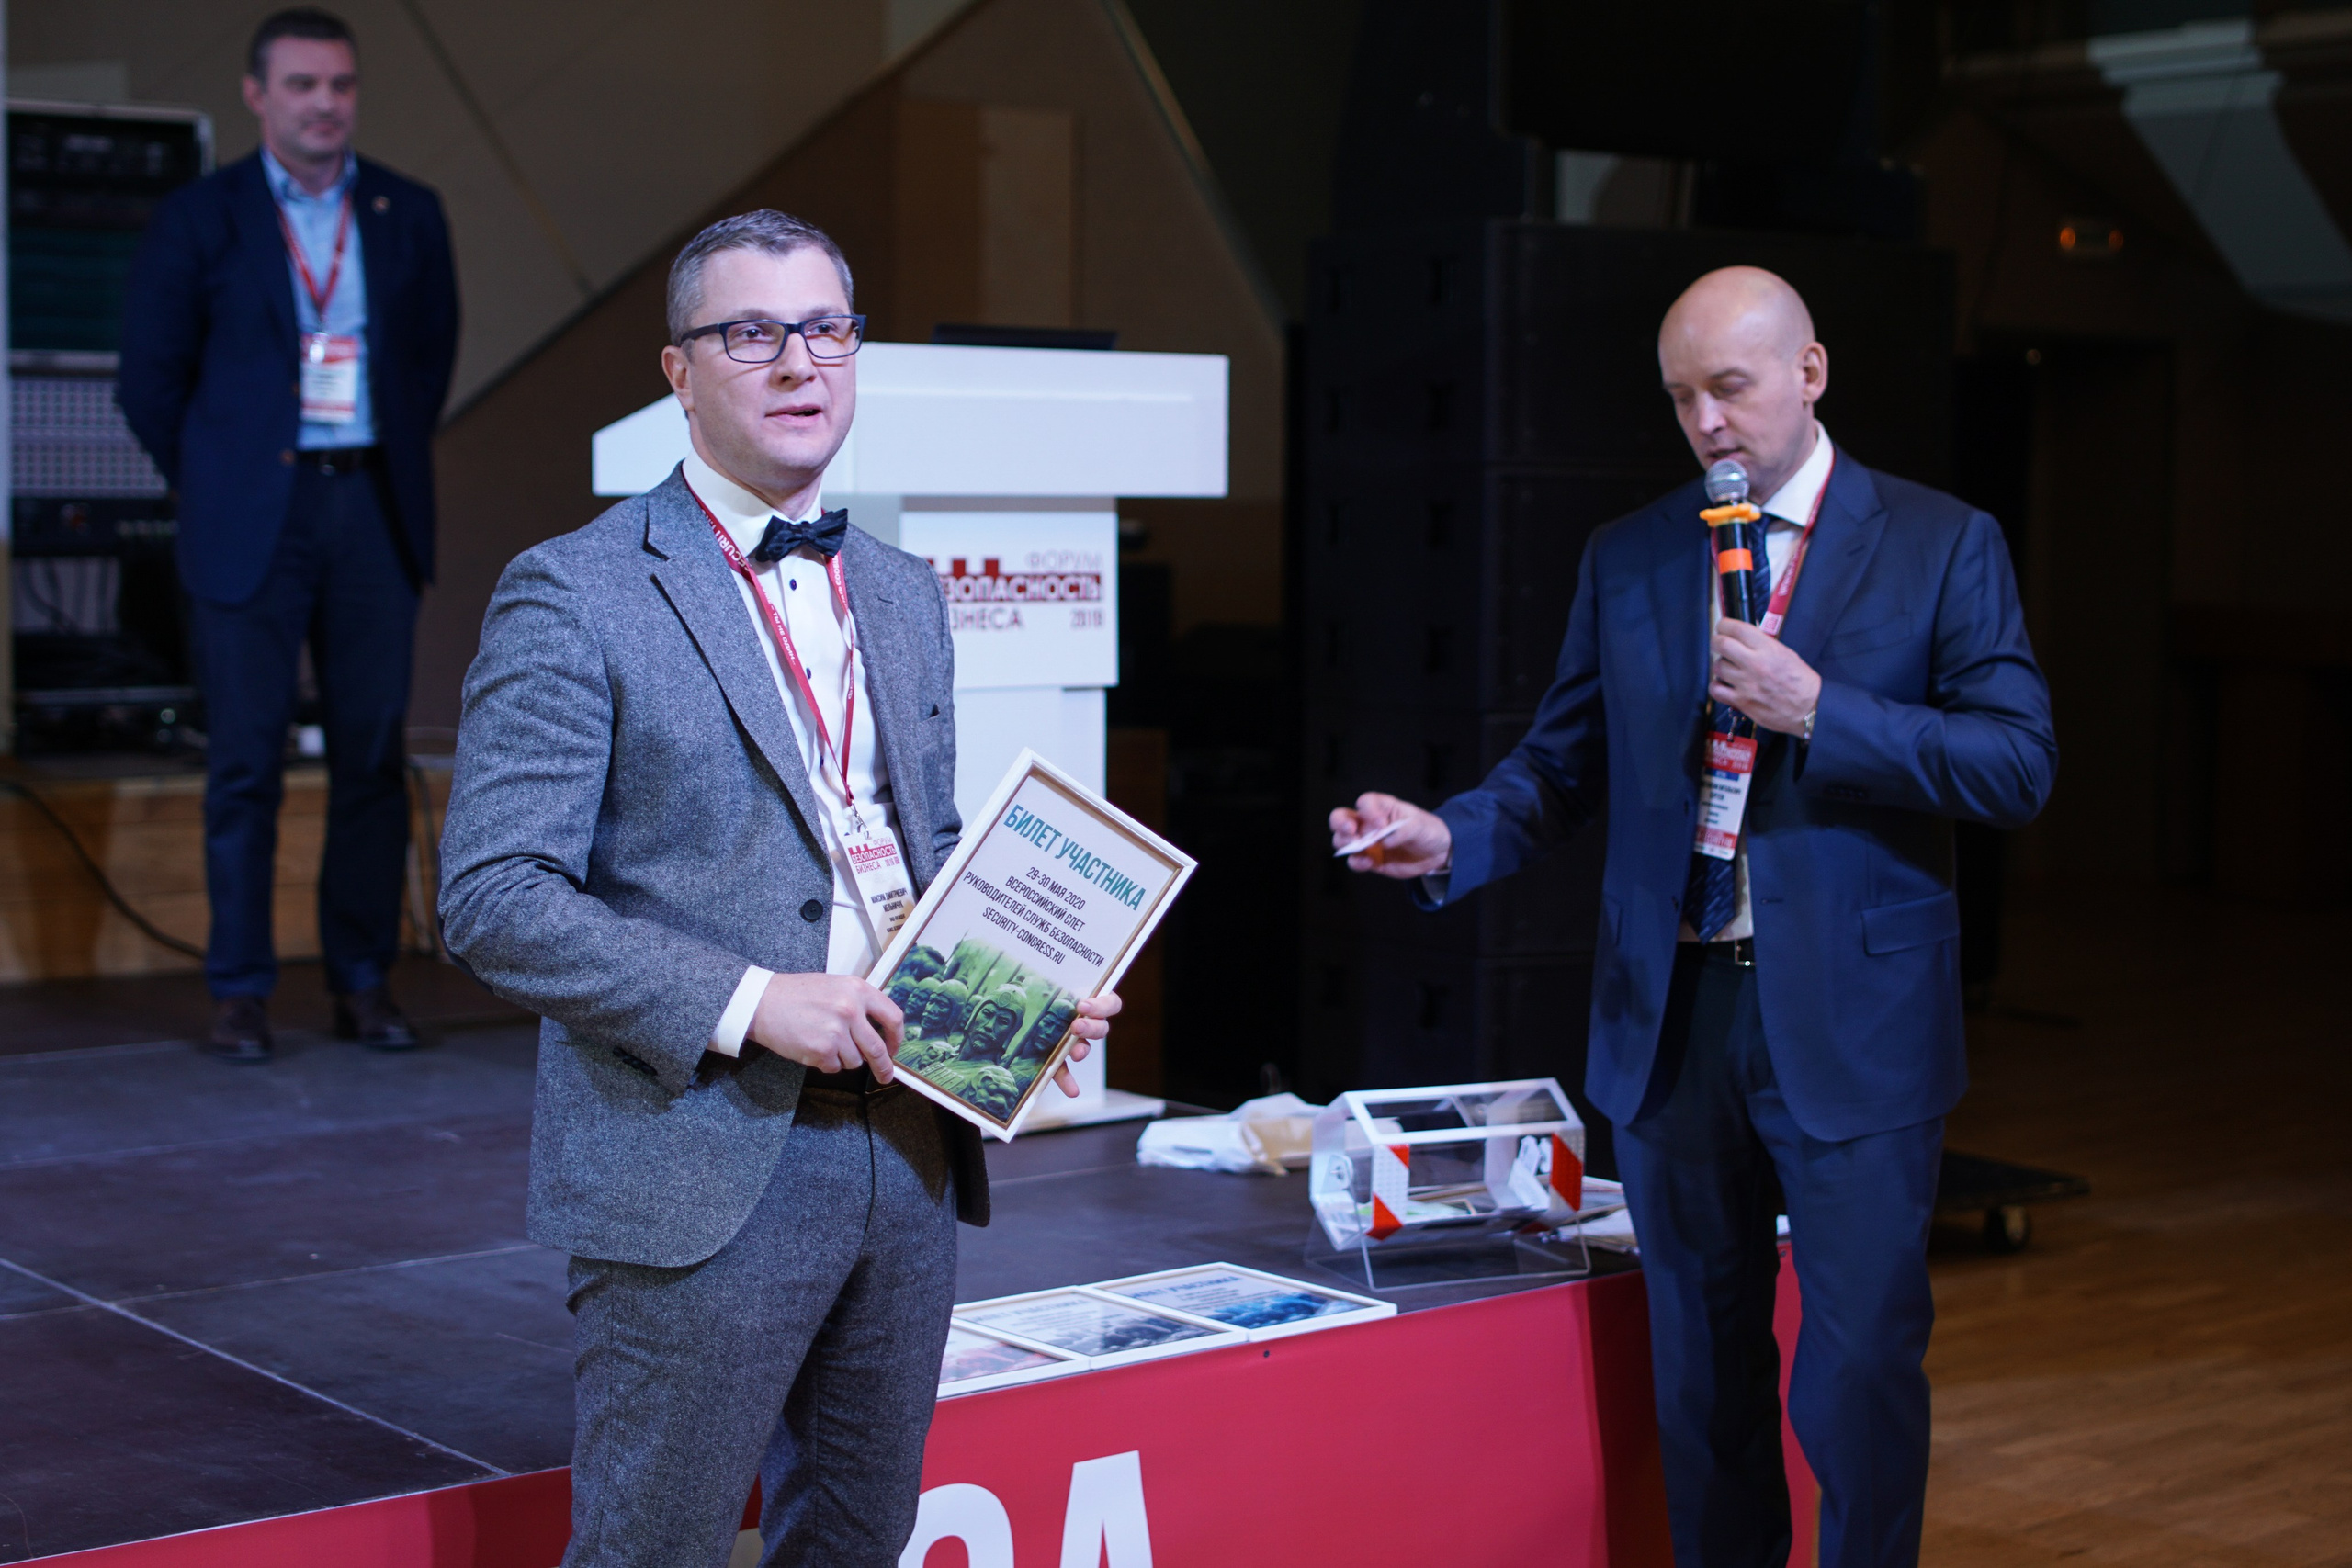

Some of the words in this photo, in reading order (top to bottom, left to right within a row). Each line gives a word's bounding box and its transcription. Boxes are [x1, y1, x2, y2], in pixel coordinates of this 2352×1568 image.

[941, 575, 1100, 601] ЗОПАСНОСТЬ
[951, 607, 1023, 629] ЗНЕСА
[852, 846, 897, 863] БЕЗОПАСНОСТЬ
[1003, 803, 1063, 852] БИЛЕТ
[1054, 837, 1147, 911] УЧАСТНИКА
[1005, 875, 1069, 922] ВСЕРОССИЙСКИЙ
[1063, 913, 1086, 932] СЛЕТ
[1026, 866, 1051, 888] 29-30
[1047, 879, 1069, 898] МАЯ
[1064, 888, 1087, 911] 2020
[963, 871, 1026, 918] РУКОВОДИТЕЛЕЙ
[1023, 910, 1052, 933] СЛУЖБ
[1048, 927, 1105, 967] БЕЗОПАСНОСТИ
[982, 906, 1066, 964] SECURITY-CONGRESS.RU
